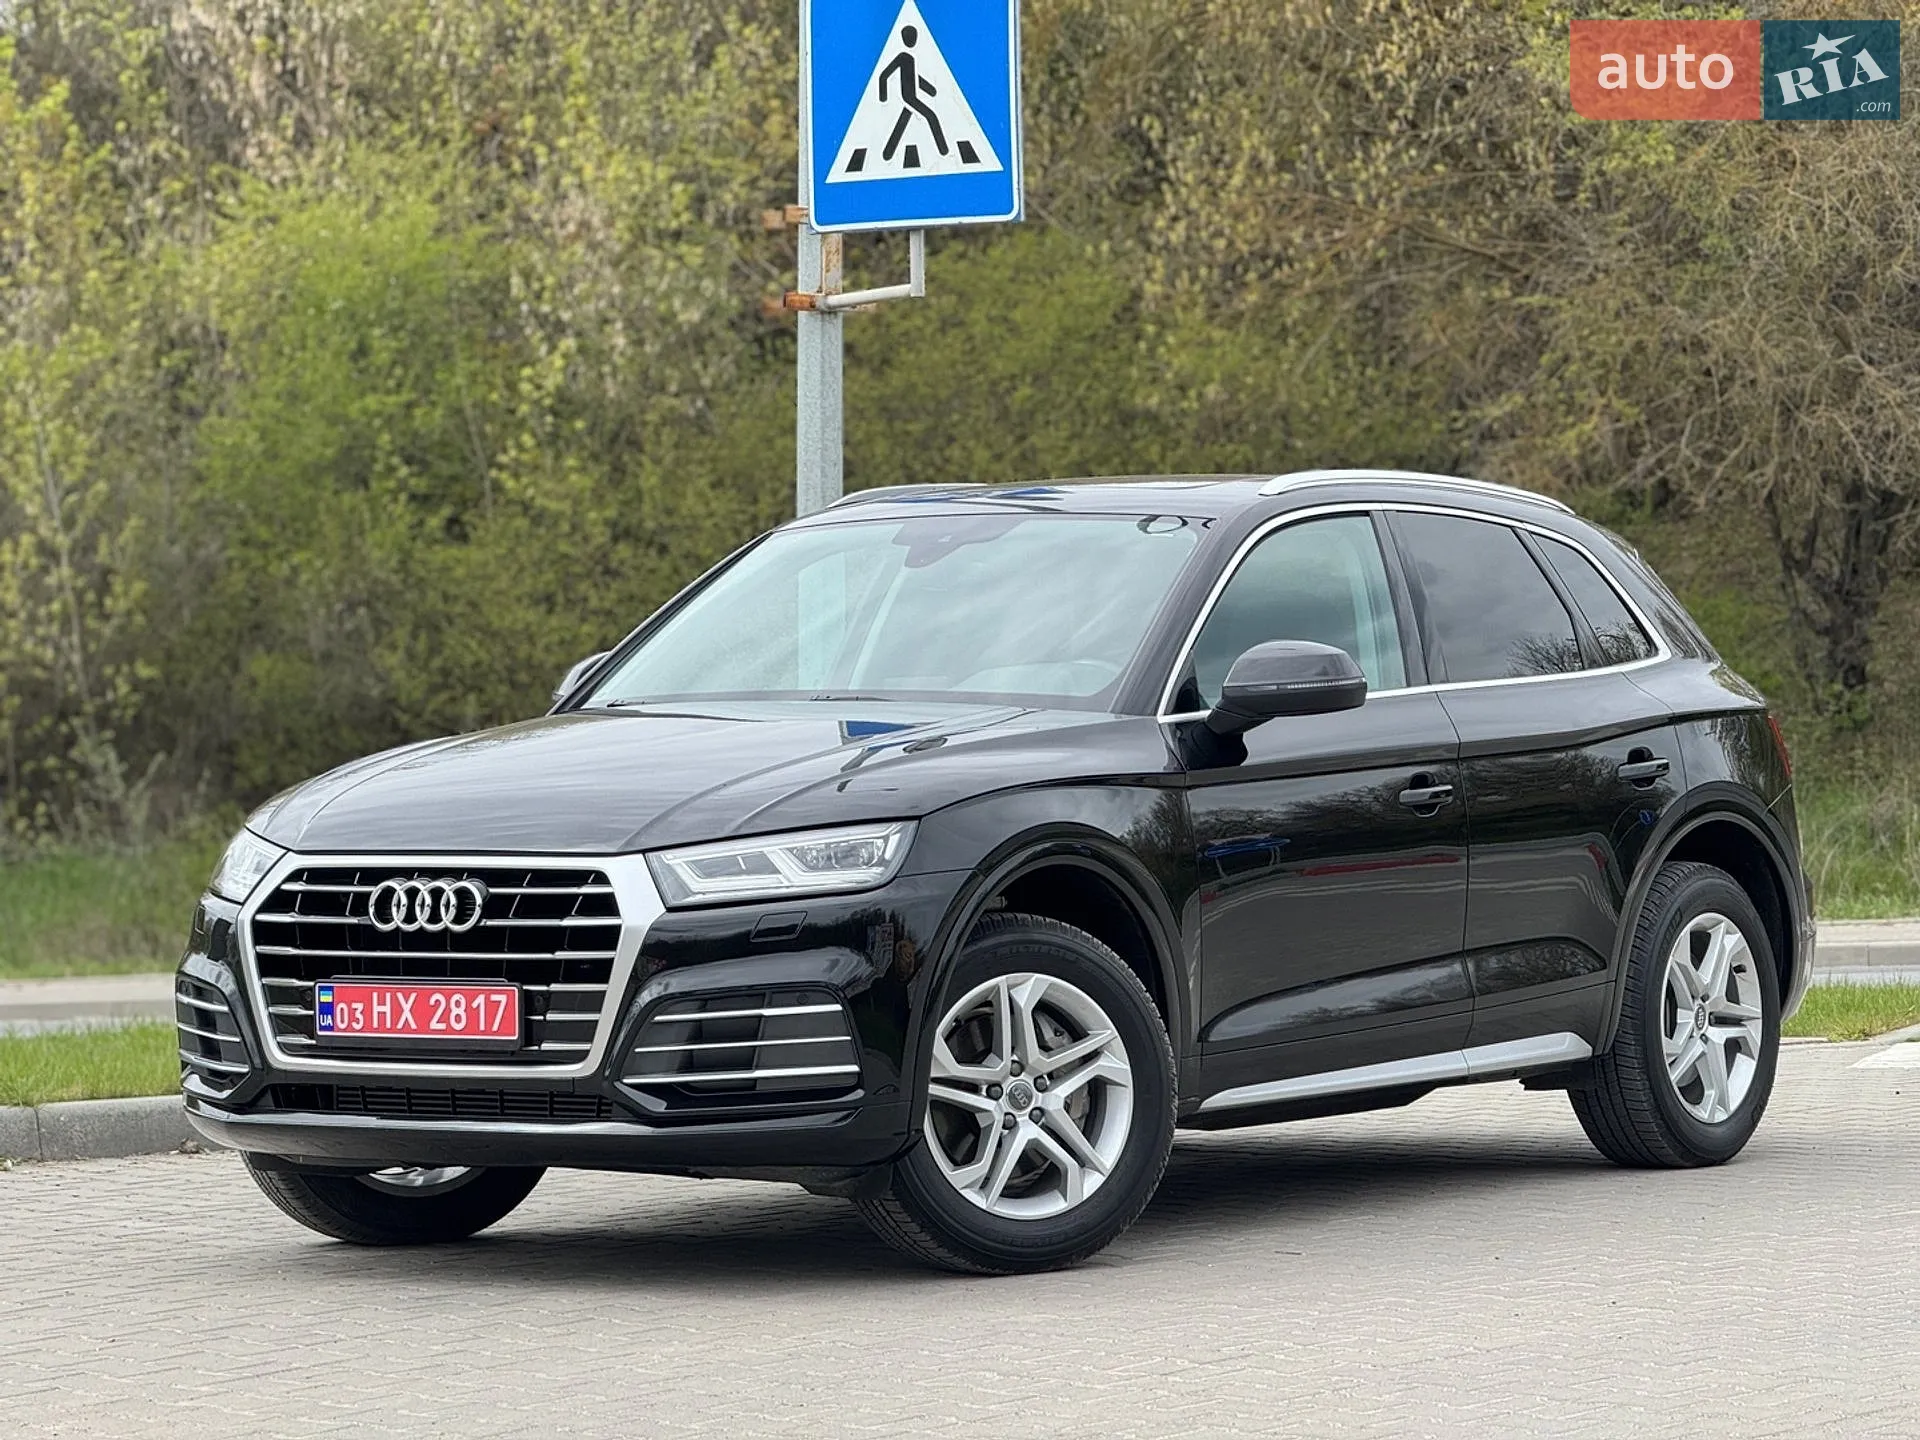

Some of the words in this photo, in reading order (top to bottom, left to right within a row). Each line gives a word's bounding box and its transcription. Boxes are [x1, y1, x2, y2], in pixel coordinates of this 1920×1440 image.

[319, 1014, 333, 1026] UA
[336, 1002, 364, 1030] 03
[372, 991, 418, 1030] HX
[429, 993, 508, 1032] 2817
